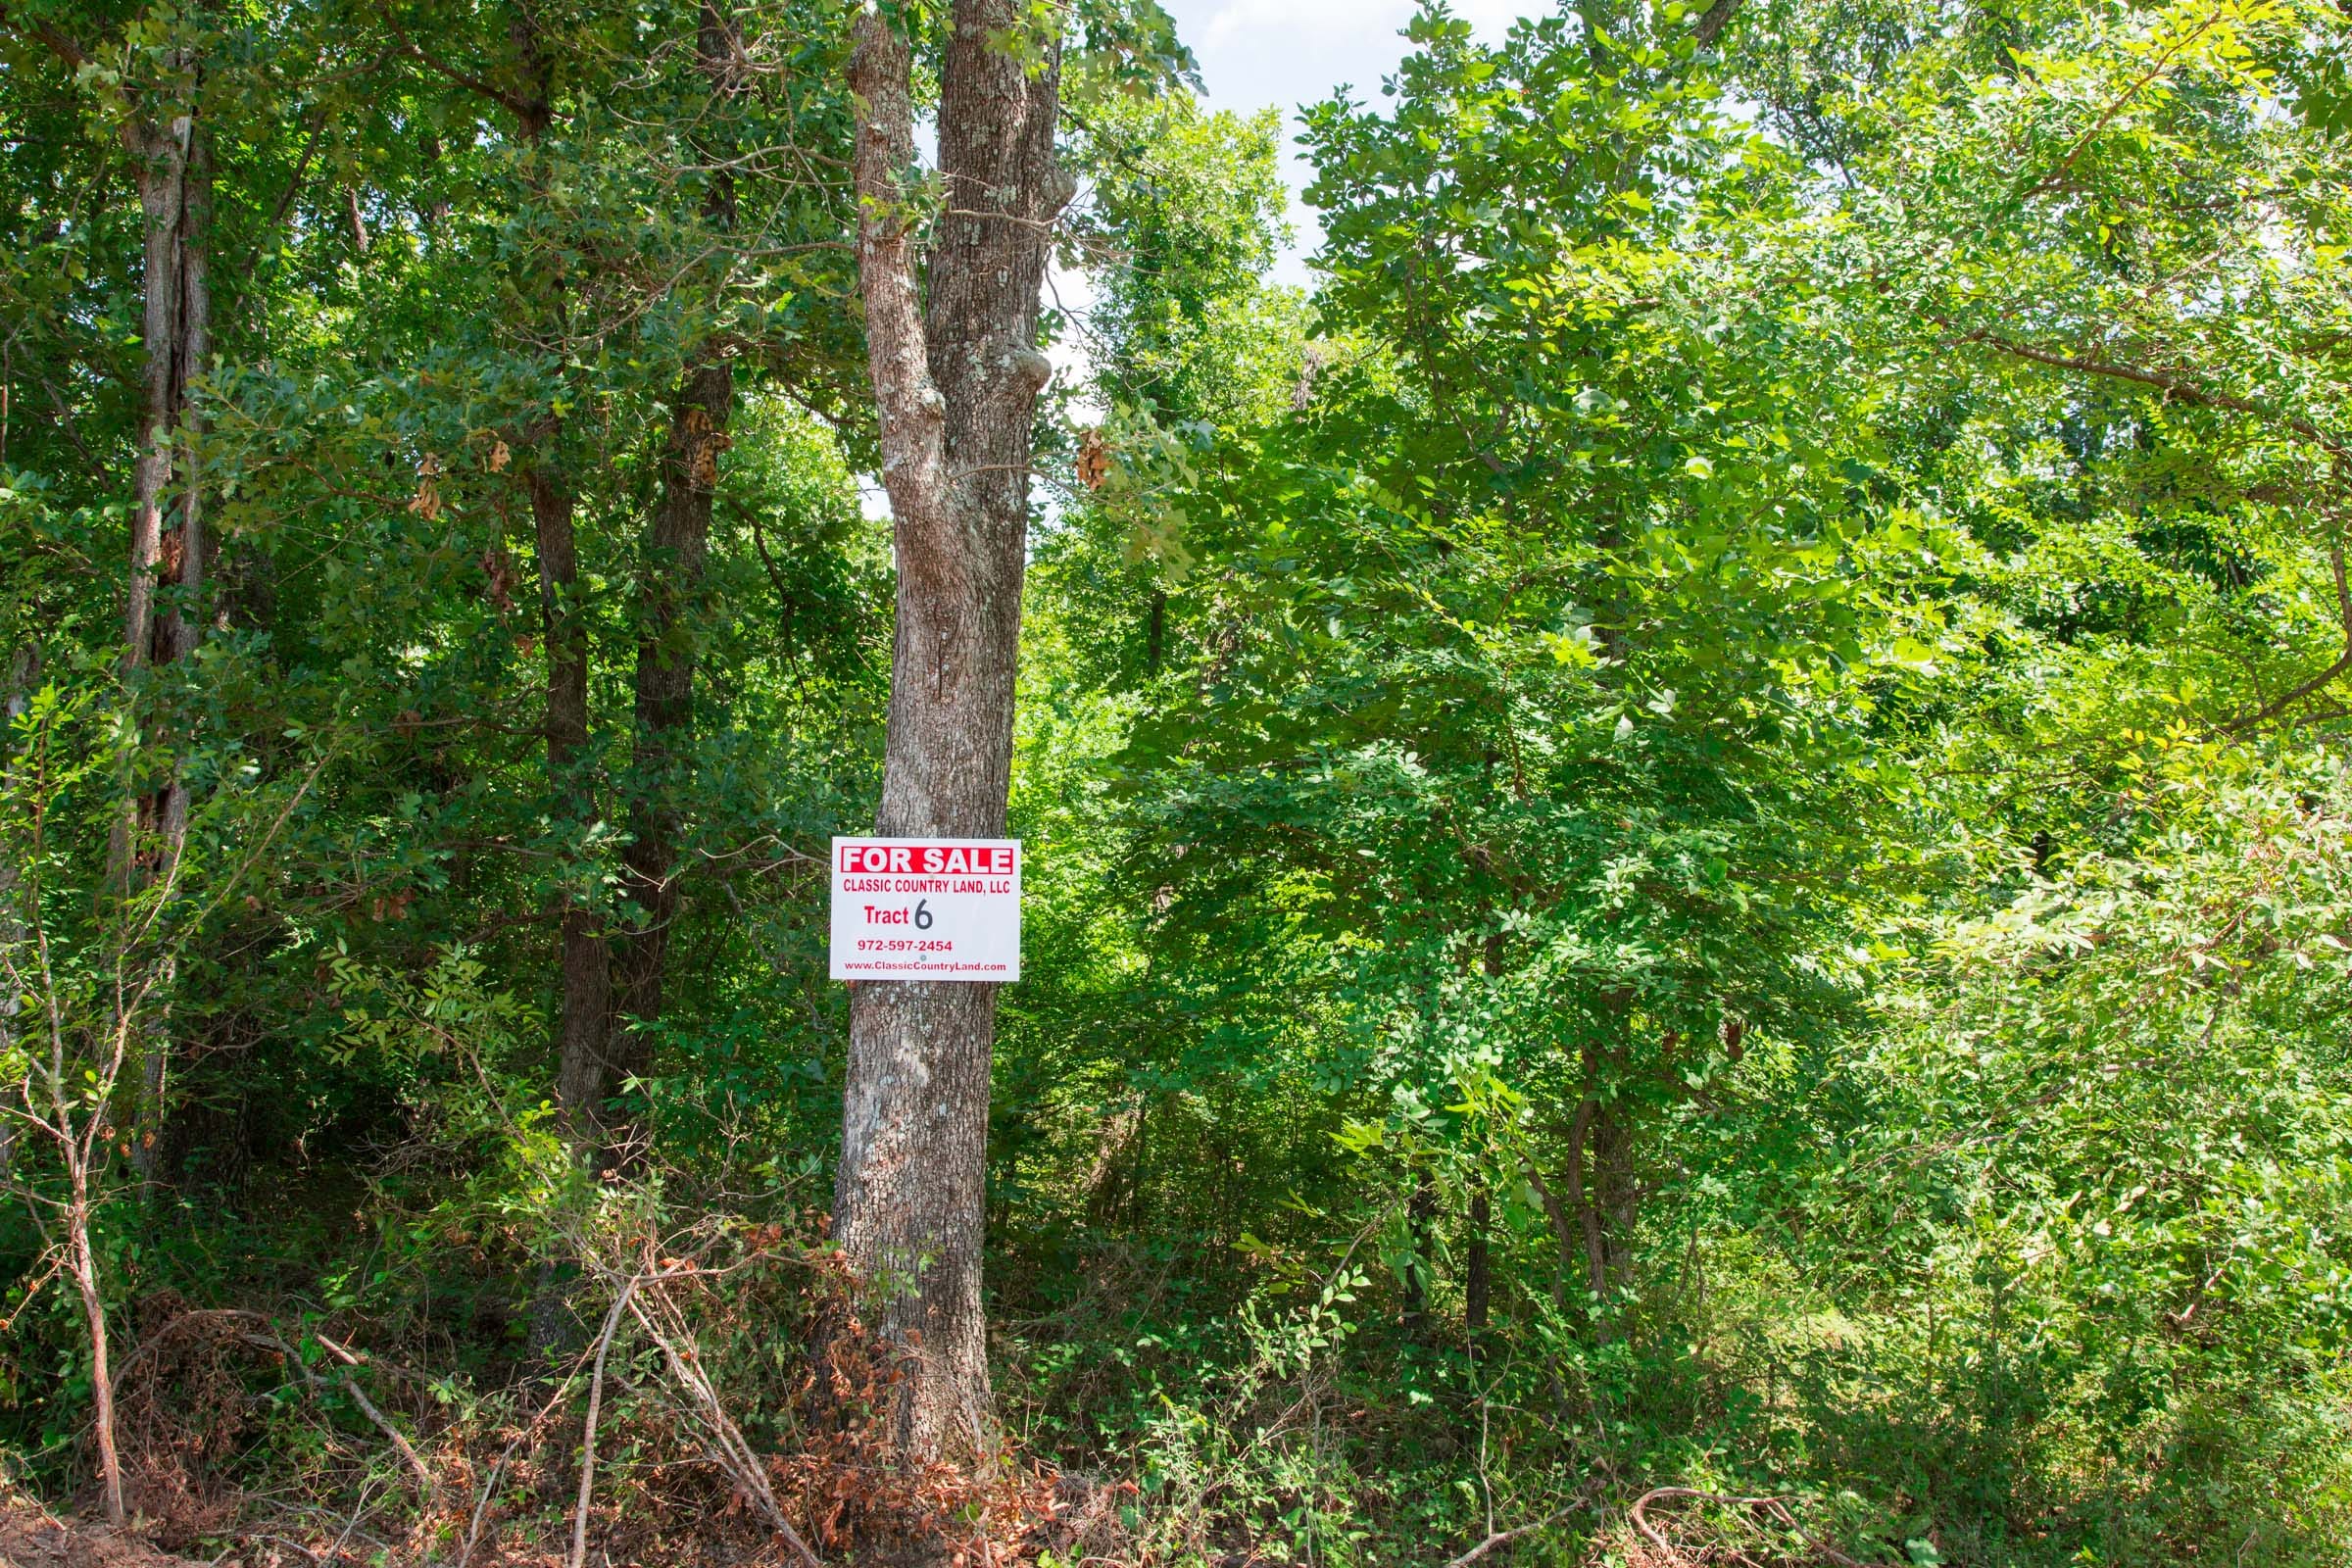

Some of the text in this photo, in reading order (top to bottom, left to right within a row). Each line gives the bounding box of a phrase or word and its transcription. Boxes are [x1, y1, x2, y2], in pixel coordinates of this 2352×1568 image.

[843, 848, 1010, 873] FOR SALE
[843, 879, 1010, 896] CLASSIC COUNTRY LAND, LLC
[864, 898, 933, 930] Tract 6
[858, 940, 953, 952] 972-597-2454
[845, 960, 1006, 973] www.ClassicCountryLand.com
